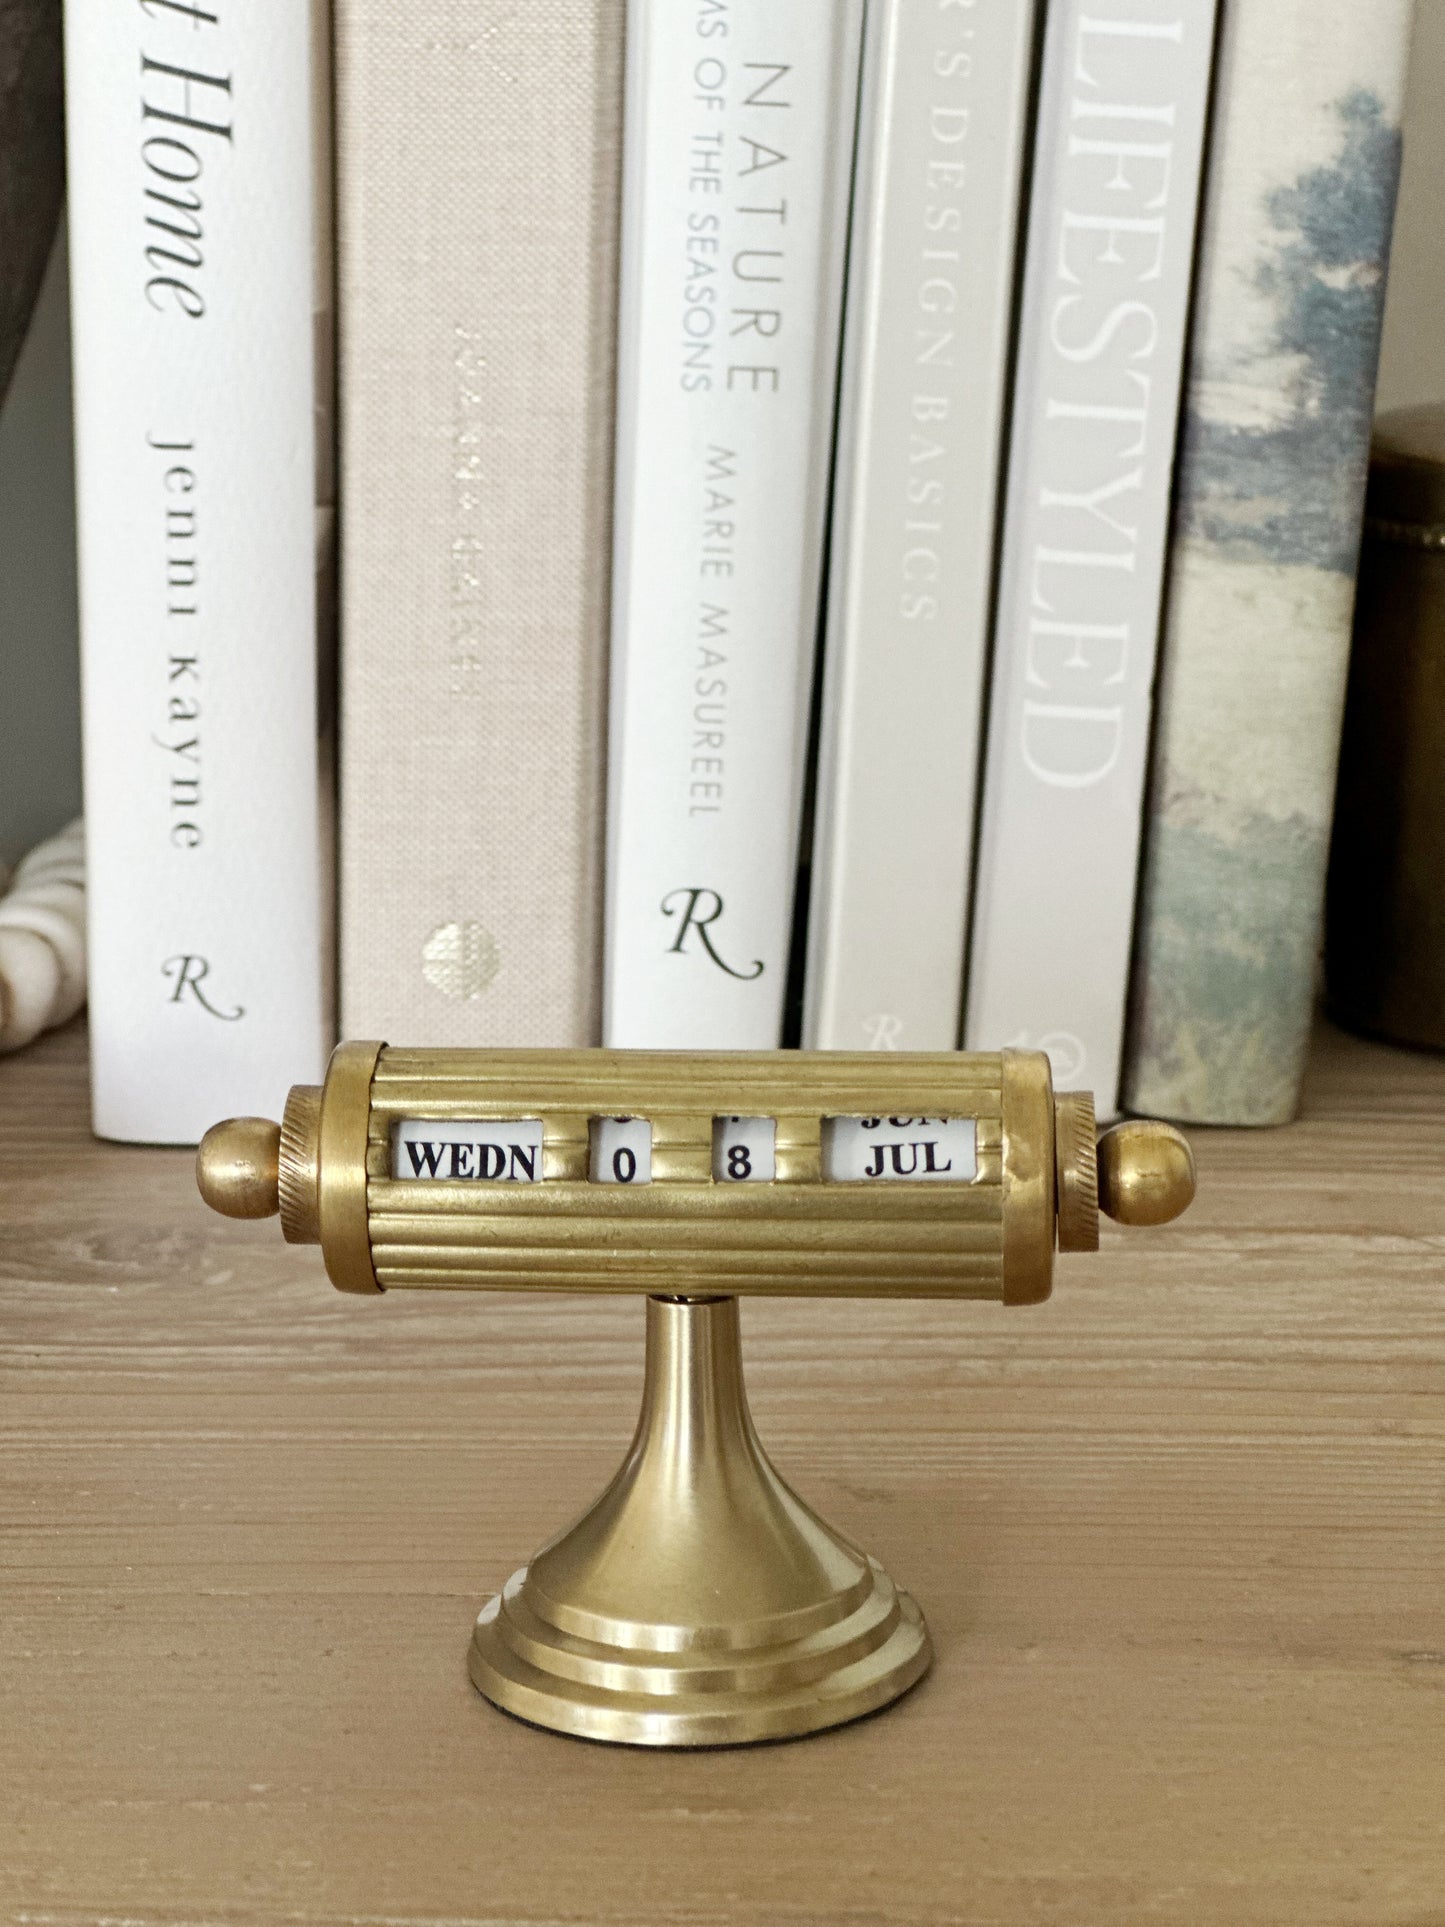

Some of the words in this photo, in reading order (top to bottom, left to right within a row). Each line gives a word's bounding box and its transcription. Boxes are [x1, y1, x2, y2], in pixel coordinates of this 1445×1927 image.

[689, 131, 725, 195] THE
[693, 57, 727, 111] OF
[140, 49, 233, 319] Home
[726, 61, 793, 393] NATURE
[916, 106, 969, 368] DESIGN
[680, 212, 720, 394] SEASONS
[1021, 14, 1184, 789] LIFESTYLED
[701, 443, 739, 580] MARIE
[901, 394, 949, 622] BASICS
[688, 602, 732, 818] MASUREEL
[160, 953, 247, 1022] R
[660, 887, 765, 981] R
[403, 1140, 539, 1182] WEDN
[612, 1146, 637, 1183] 0
[727, 1144, 752, 1180] 8
[864, 1140, 953, 1178] JUL
